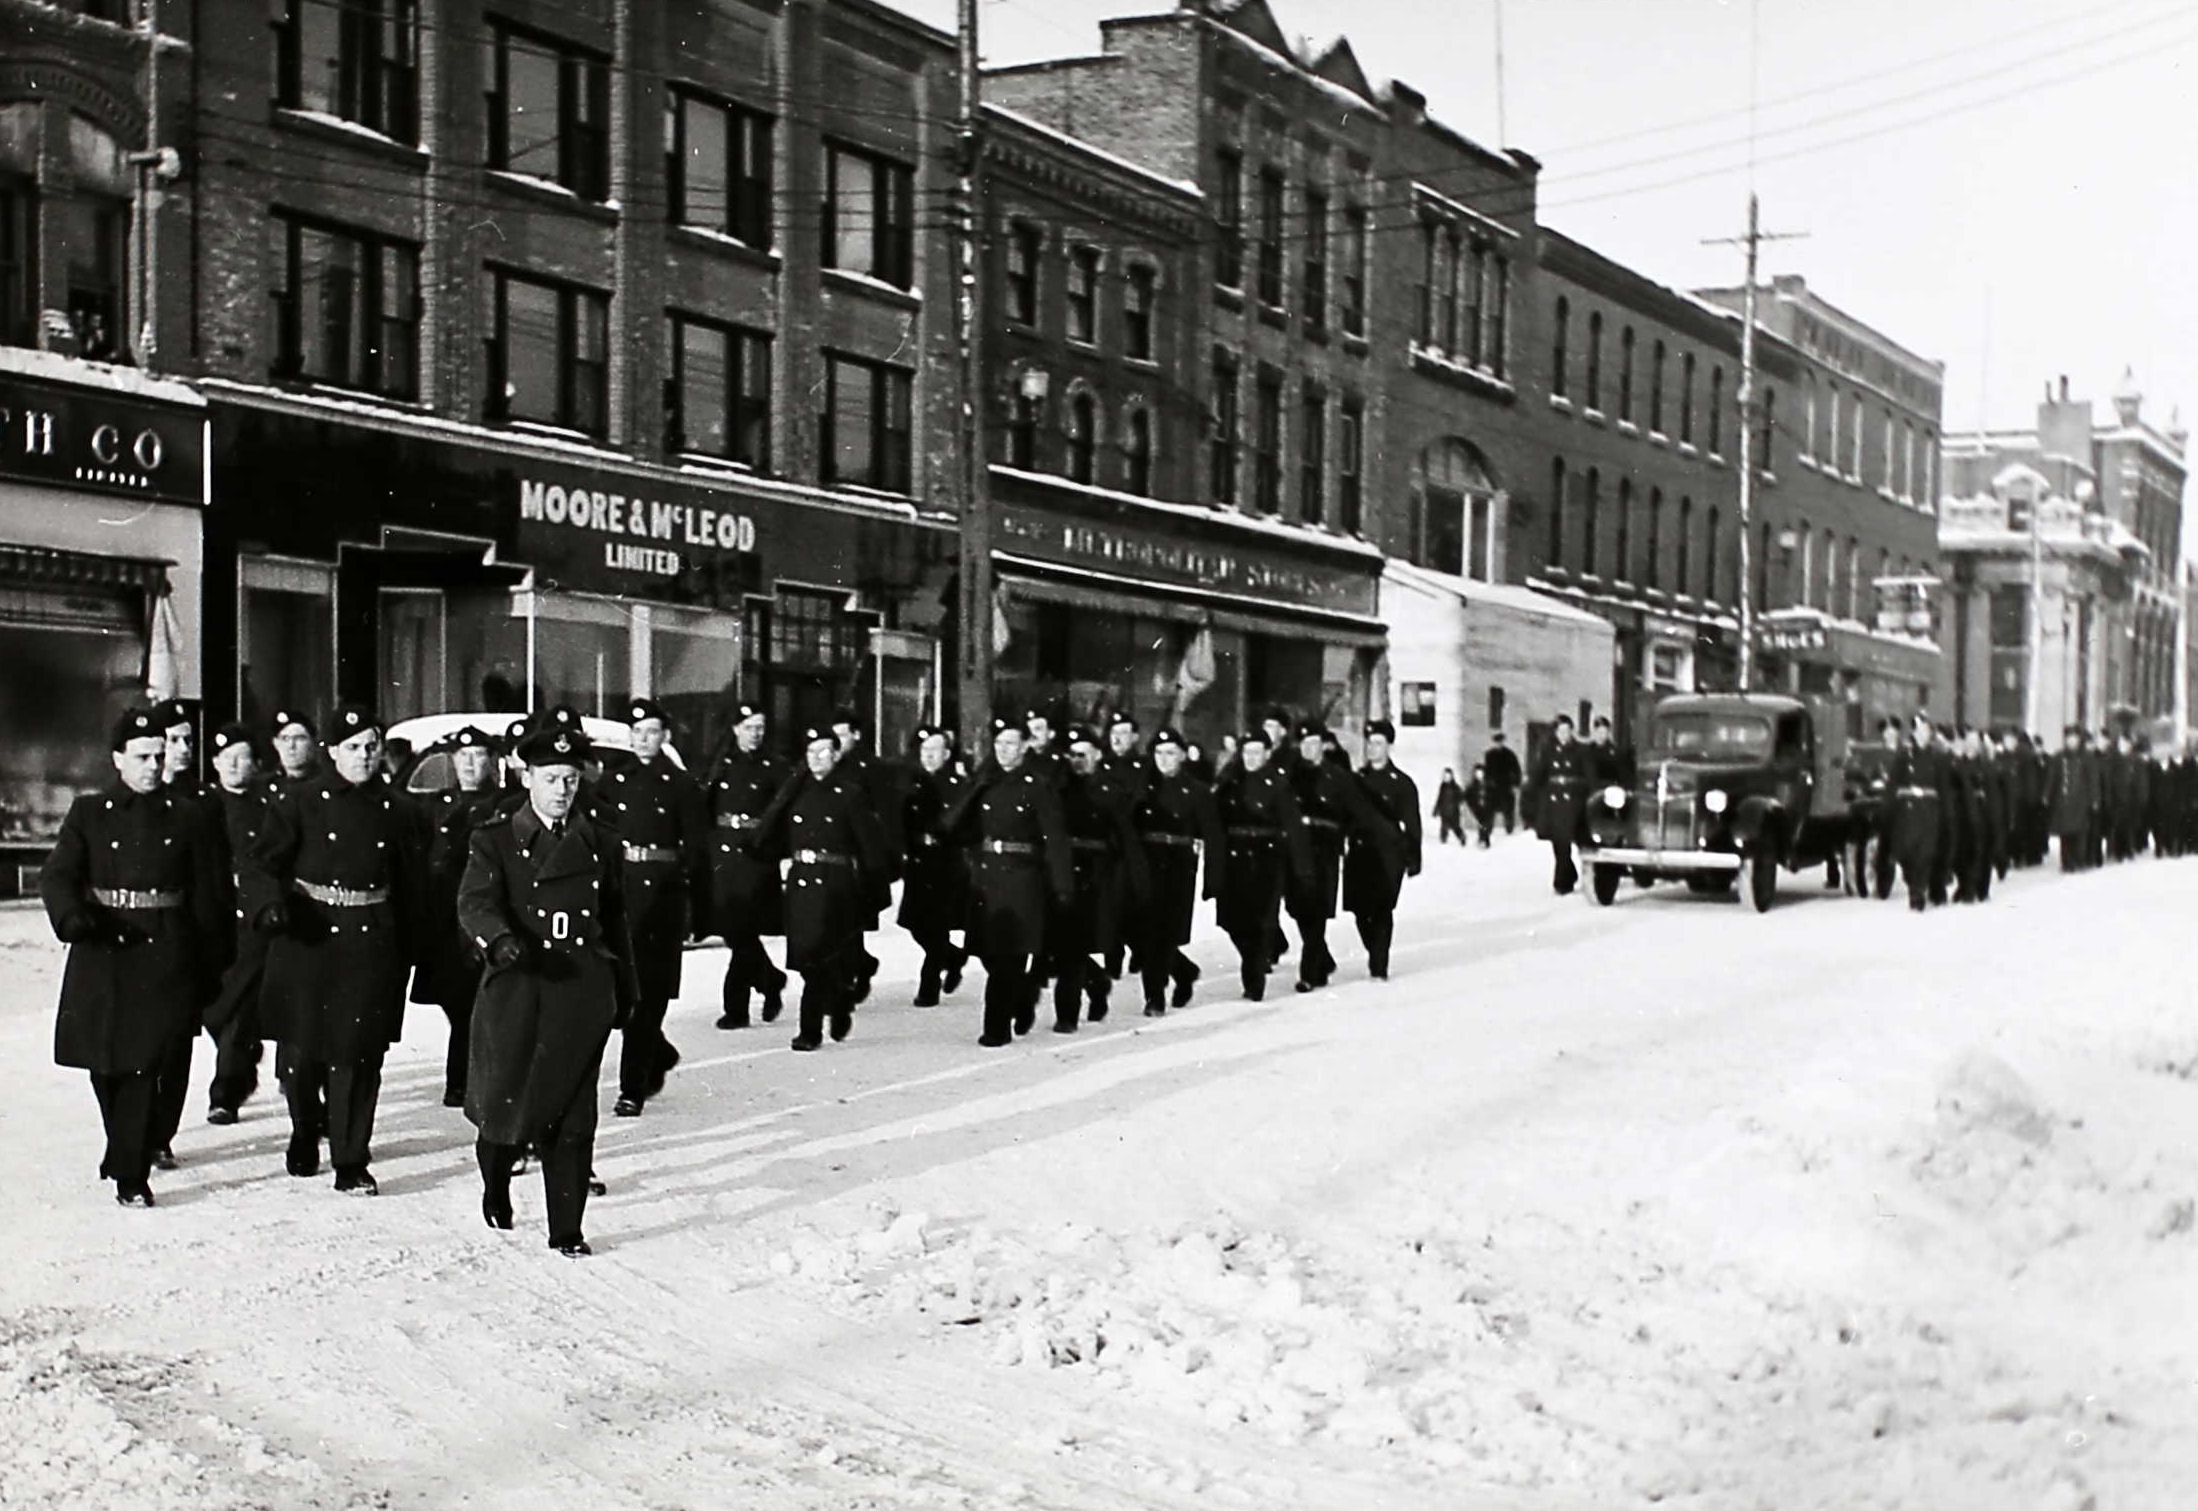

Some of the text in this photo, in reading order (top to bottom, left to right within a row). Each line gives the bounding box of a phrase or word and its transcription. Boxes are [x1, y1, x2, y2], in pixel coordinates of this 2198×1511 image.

[91, 424, 162, 469] CO
[520, 479, 756, 553] MOORE & McLEOD
[605, 542, 680, 576] LIMITED
